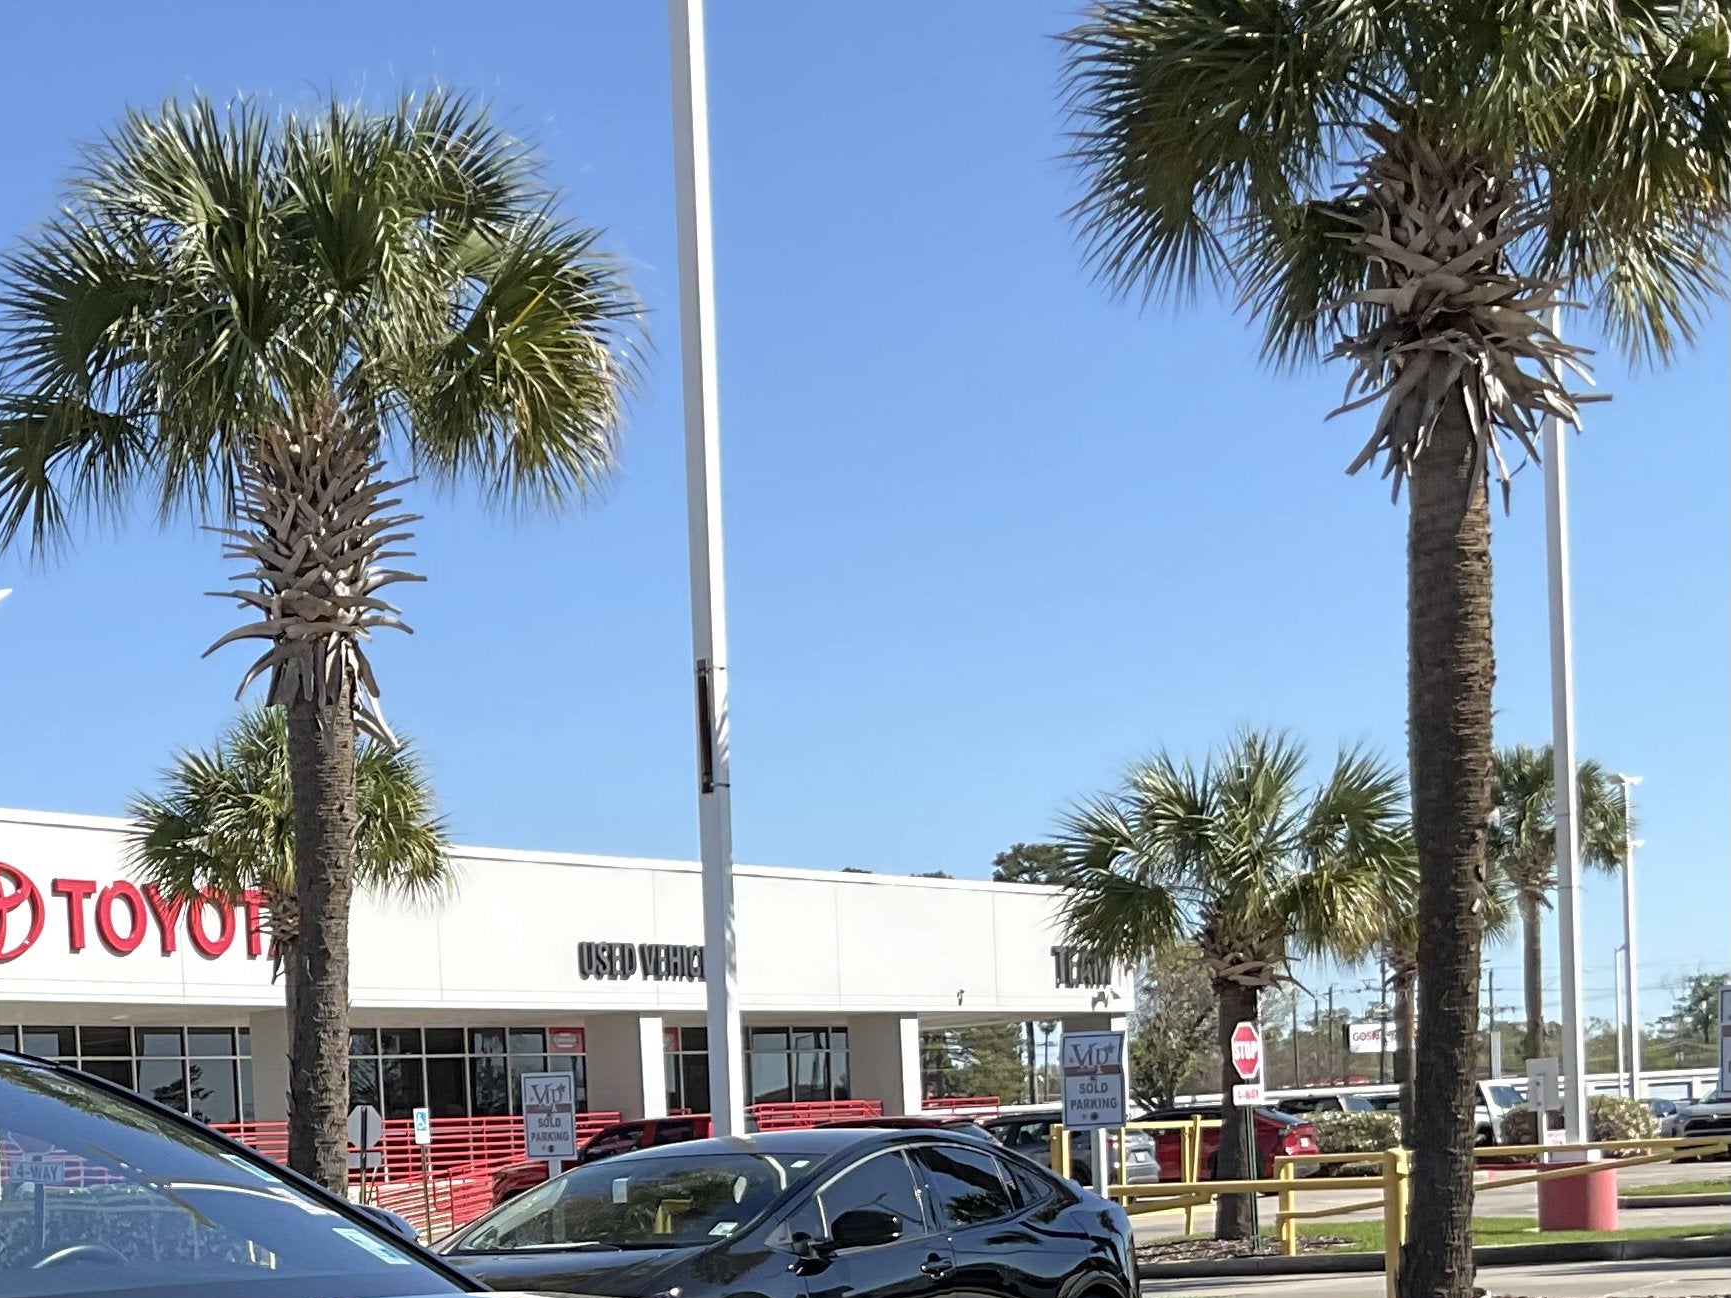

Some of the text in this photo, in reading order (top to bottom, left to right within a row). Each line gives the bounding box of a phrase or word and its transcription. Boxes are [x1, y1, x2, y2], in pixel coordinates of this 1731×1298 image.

[51, 877, 276, 960] TOYOT
[577, 941, 706, 983] USED VEHIC
[1233, 1040, 1258, 1062] STOP
[1078, 1081, 1109, 1095] SOLD
[1069, 1097, 1118, 1111] PARKING
[537, 1117, 562, 1129] SOLD
[530, 1131, 570, 1142] PARKING
[16, 1164, 58, 1181] 4-WAY
